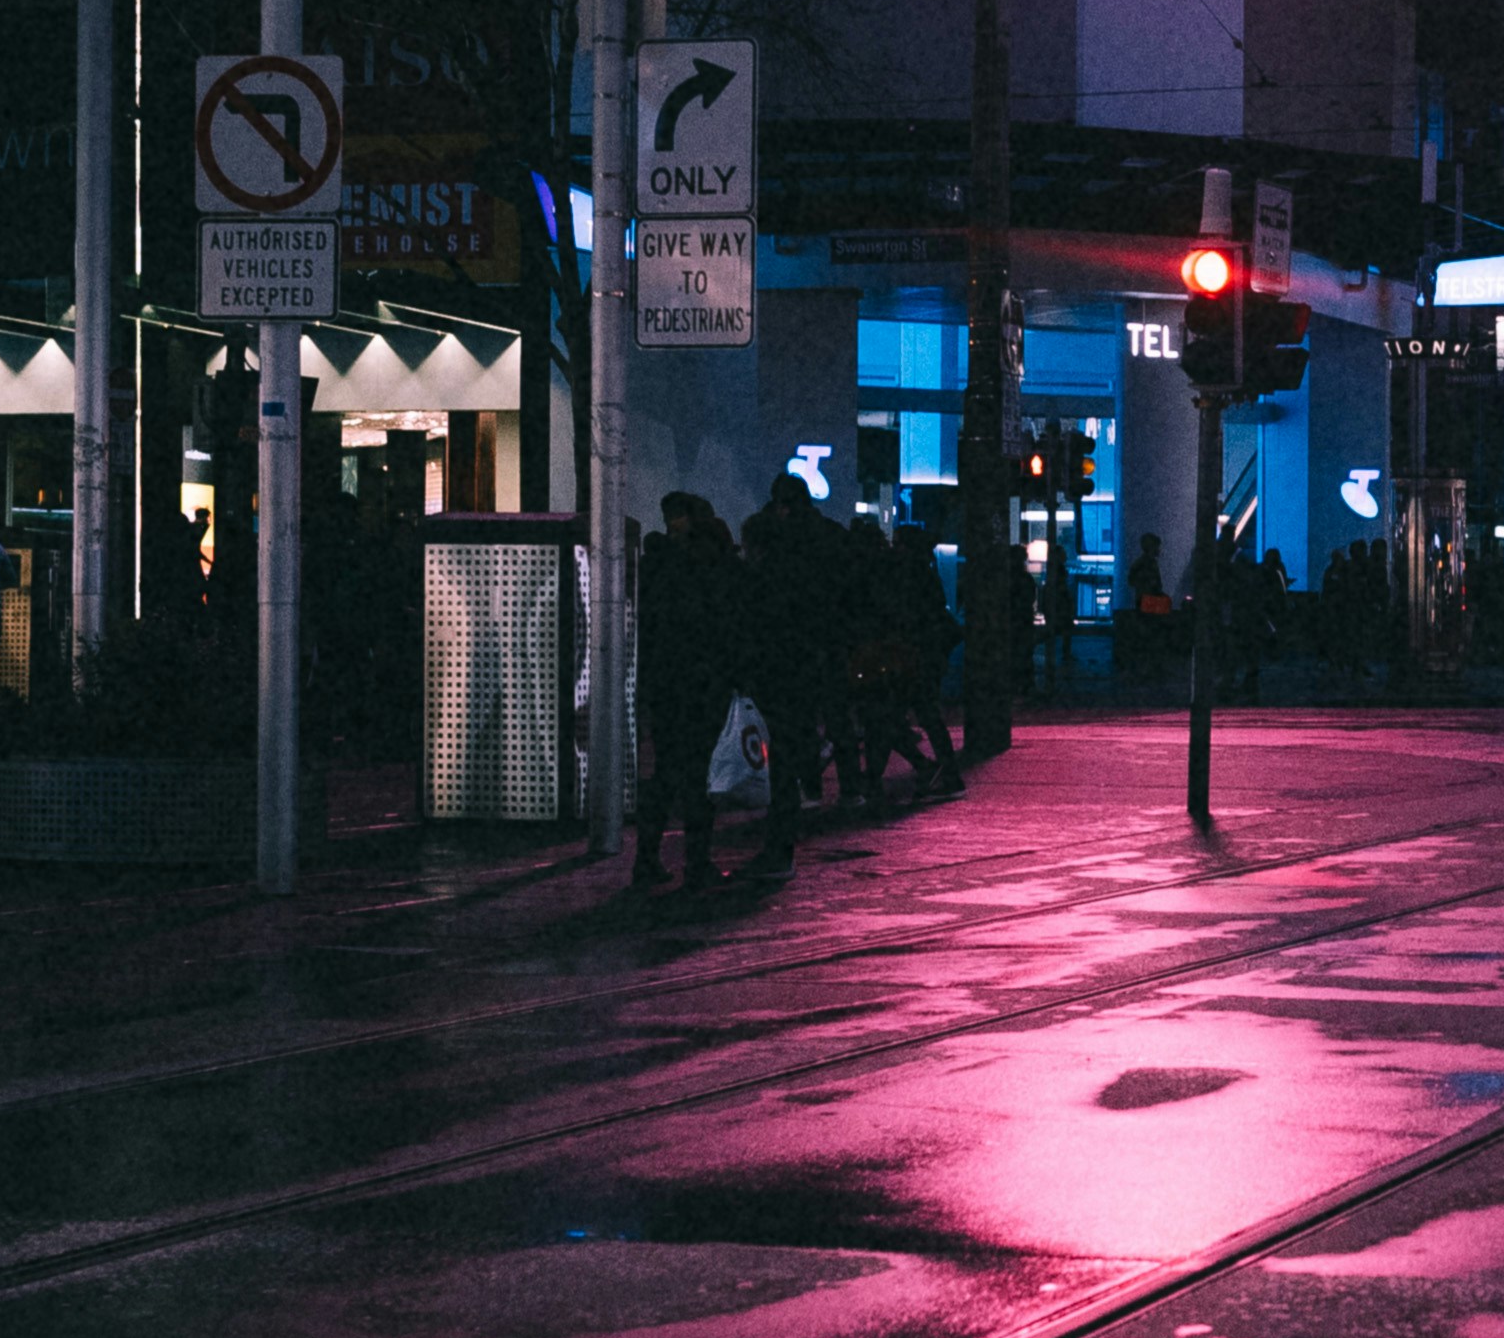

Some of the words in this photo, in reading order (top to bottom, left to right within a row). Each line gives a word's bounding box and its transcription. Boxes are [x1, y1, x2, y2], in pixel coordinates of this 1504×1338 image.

[651, 166, 736, 196] ONLY
[341, 181, 481, 227] EMIST
[210, 229, 327, 251] AUTHORISED
[642, 232, 690, 259] GIVE
[700, 231, 746, 259] WAY
[835, 238, 908, 255] Swanston
[223, 259, 314, 279] VEHICLES
[682, 270, 708, 295] TO
[220, 286, 315, 307] EXCEPTED
[645, 306, 745, 334] PEDESTRIANS
